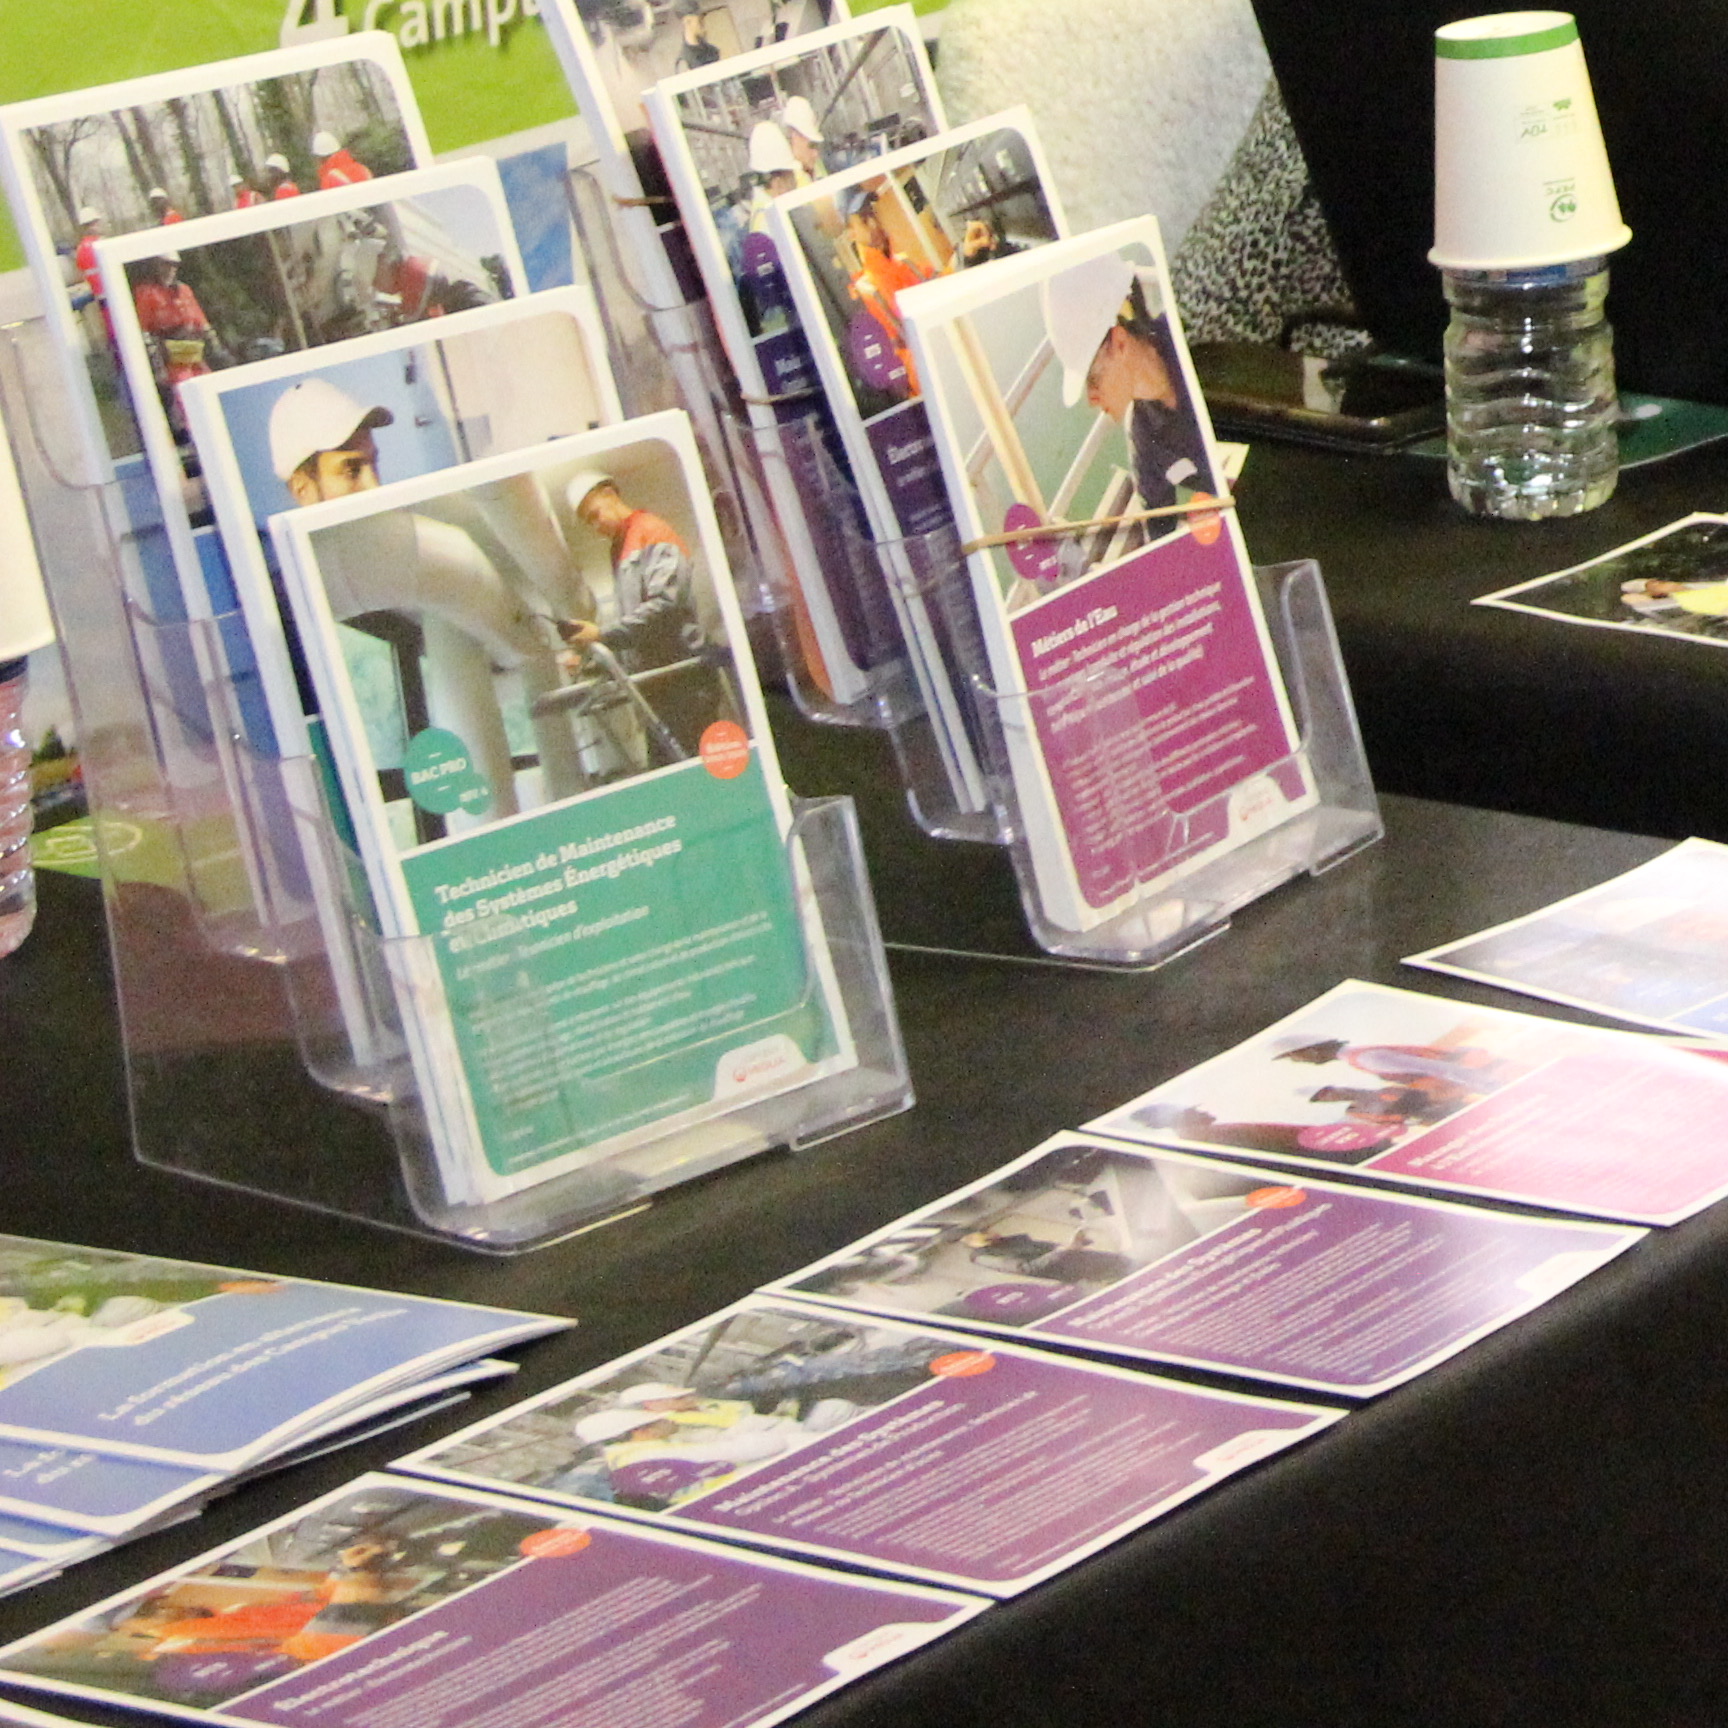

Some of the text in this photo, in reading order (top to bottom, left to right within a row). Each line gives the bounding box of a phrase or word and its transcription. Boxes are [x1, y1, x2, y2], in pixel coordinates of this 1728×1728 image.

[434, 815, 677, 904] Technicien de Maintenance
[443, 908, 475, 929] des
[476, 877, 564, 918] Systèmes
